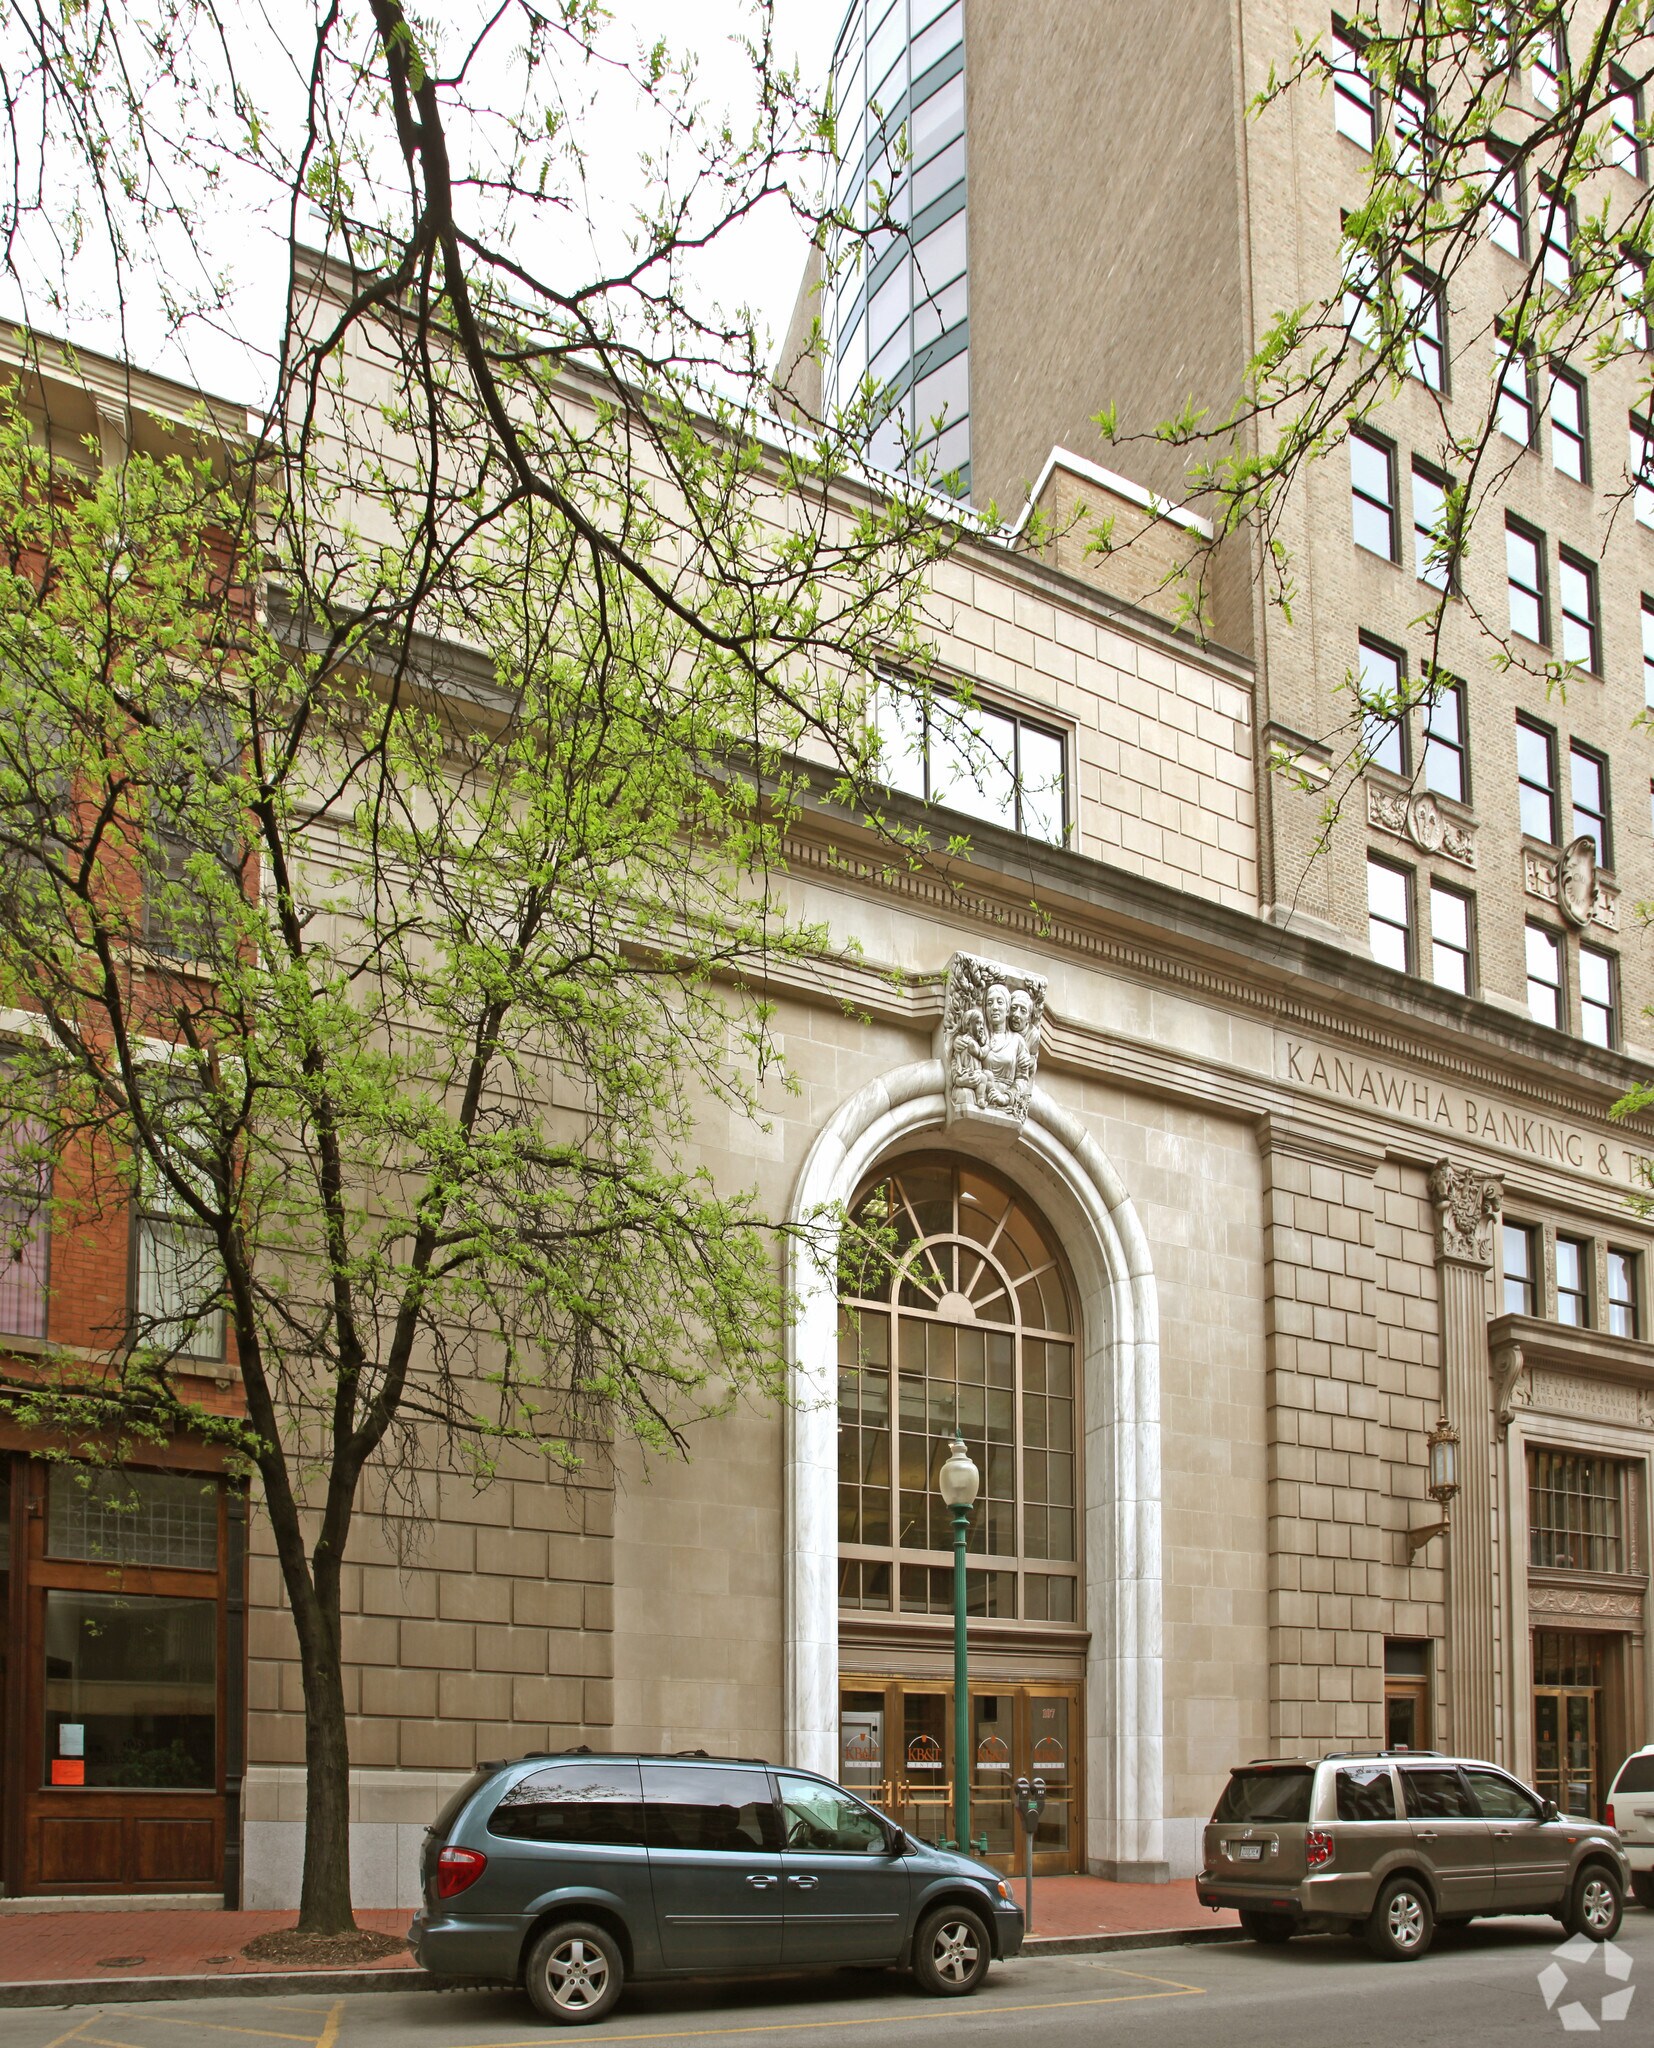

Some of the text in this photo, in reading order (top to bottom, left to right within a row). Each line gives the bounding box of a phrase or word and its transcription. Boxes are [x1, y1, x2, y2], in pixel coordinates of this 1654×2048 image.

[1287, 1041, 1453, 1128] KANAWHA
[1465, 1100, 1583, 1168] BANKING
[1597, 1142, 1612, 1176] &
[1535, 1383, 1636, 1411] THE KANAWHA BANKING
[1536, 1396, 1553, 1406] AND
[1591, 1404, 1636, 1420] COMPANY
[845, 1746, 880, 1760] KB&T
[907, 1747, 942, 1761] KB&T
[977, 1748, 1008, 1762] KB&T
